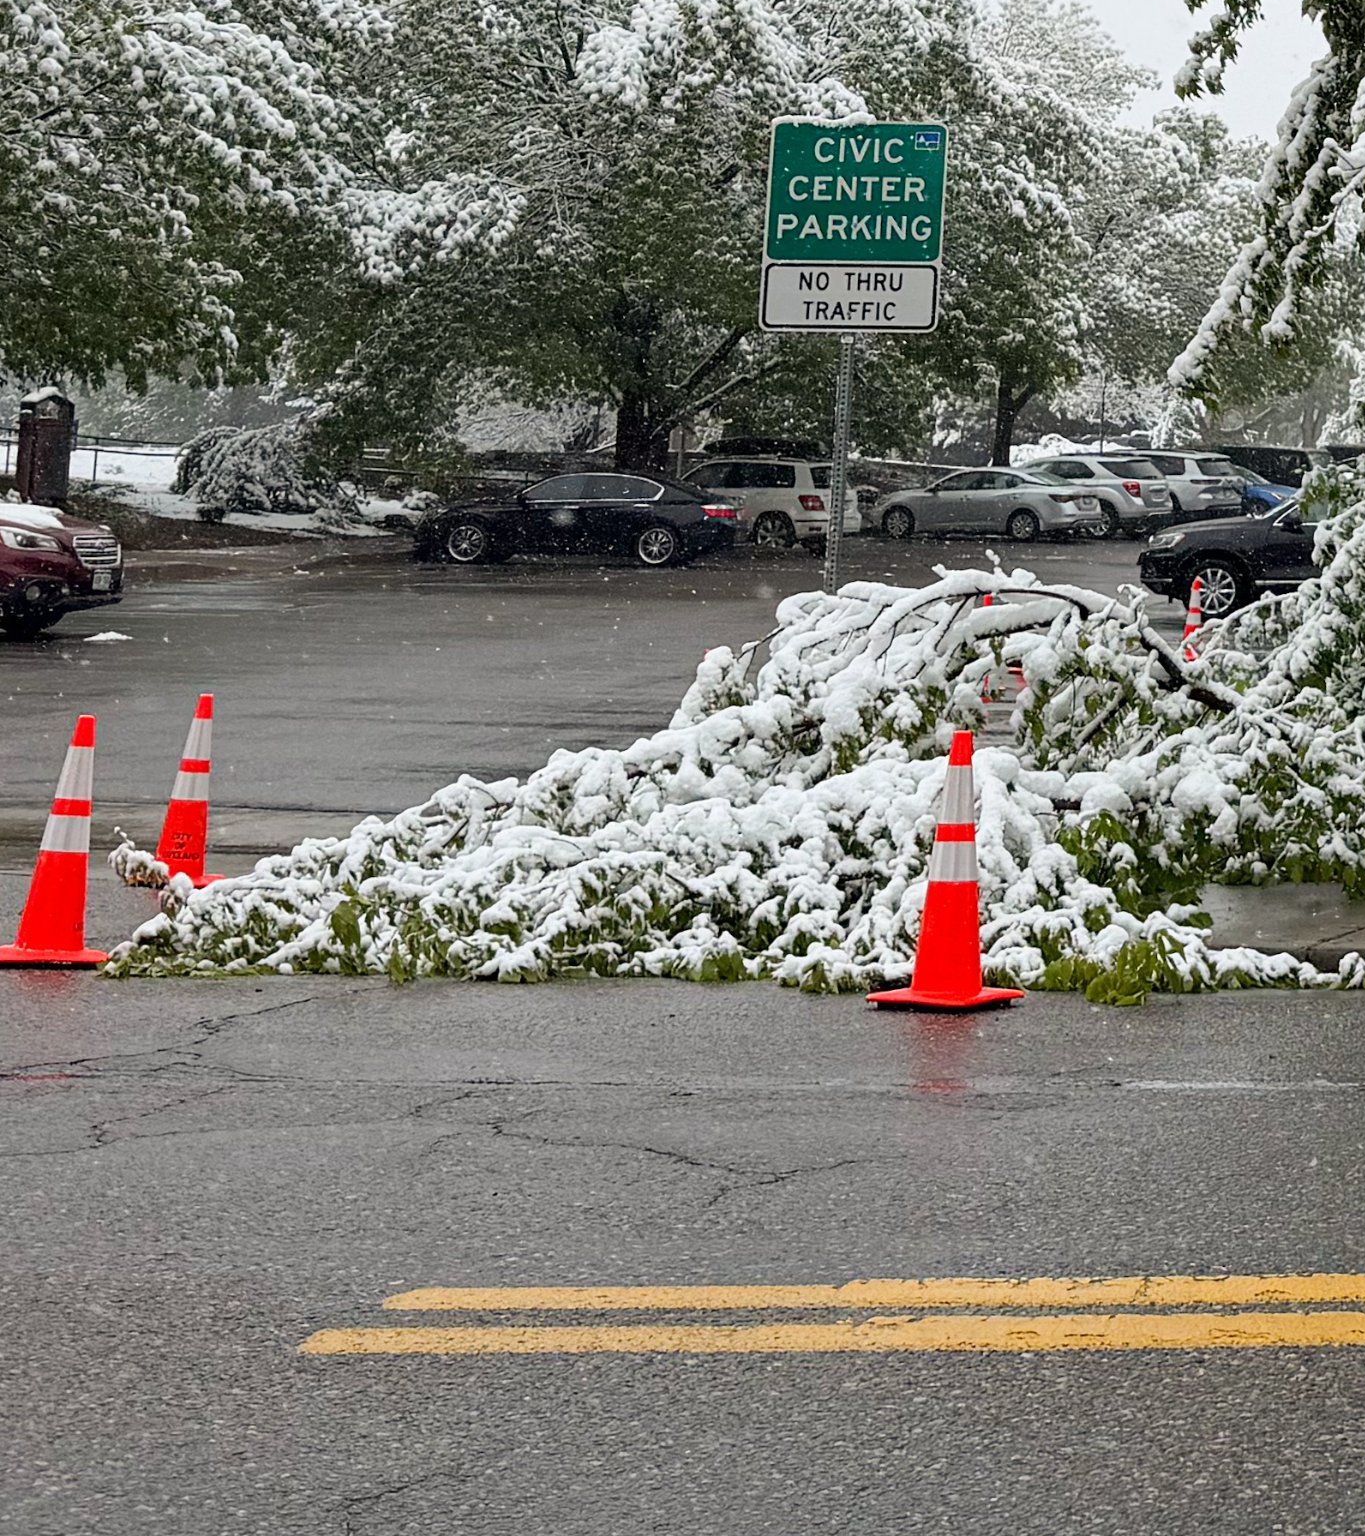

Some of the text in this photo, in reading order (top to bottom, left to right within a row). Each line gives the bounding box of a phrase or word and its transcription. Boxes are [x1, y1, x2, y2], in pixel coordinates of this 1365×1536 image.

[814, 137, 904, 163] CIVIC
[788, 175, 926, 202] CENTER
[776, 214, 932, 241] PARKING
[799, 271, 903, 292] NO THRU
[803, 301, 896, 321] TRAFFIC
